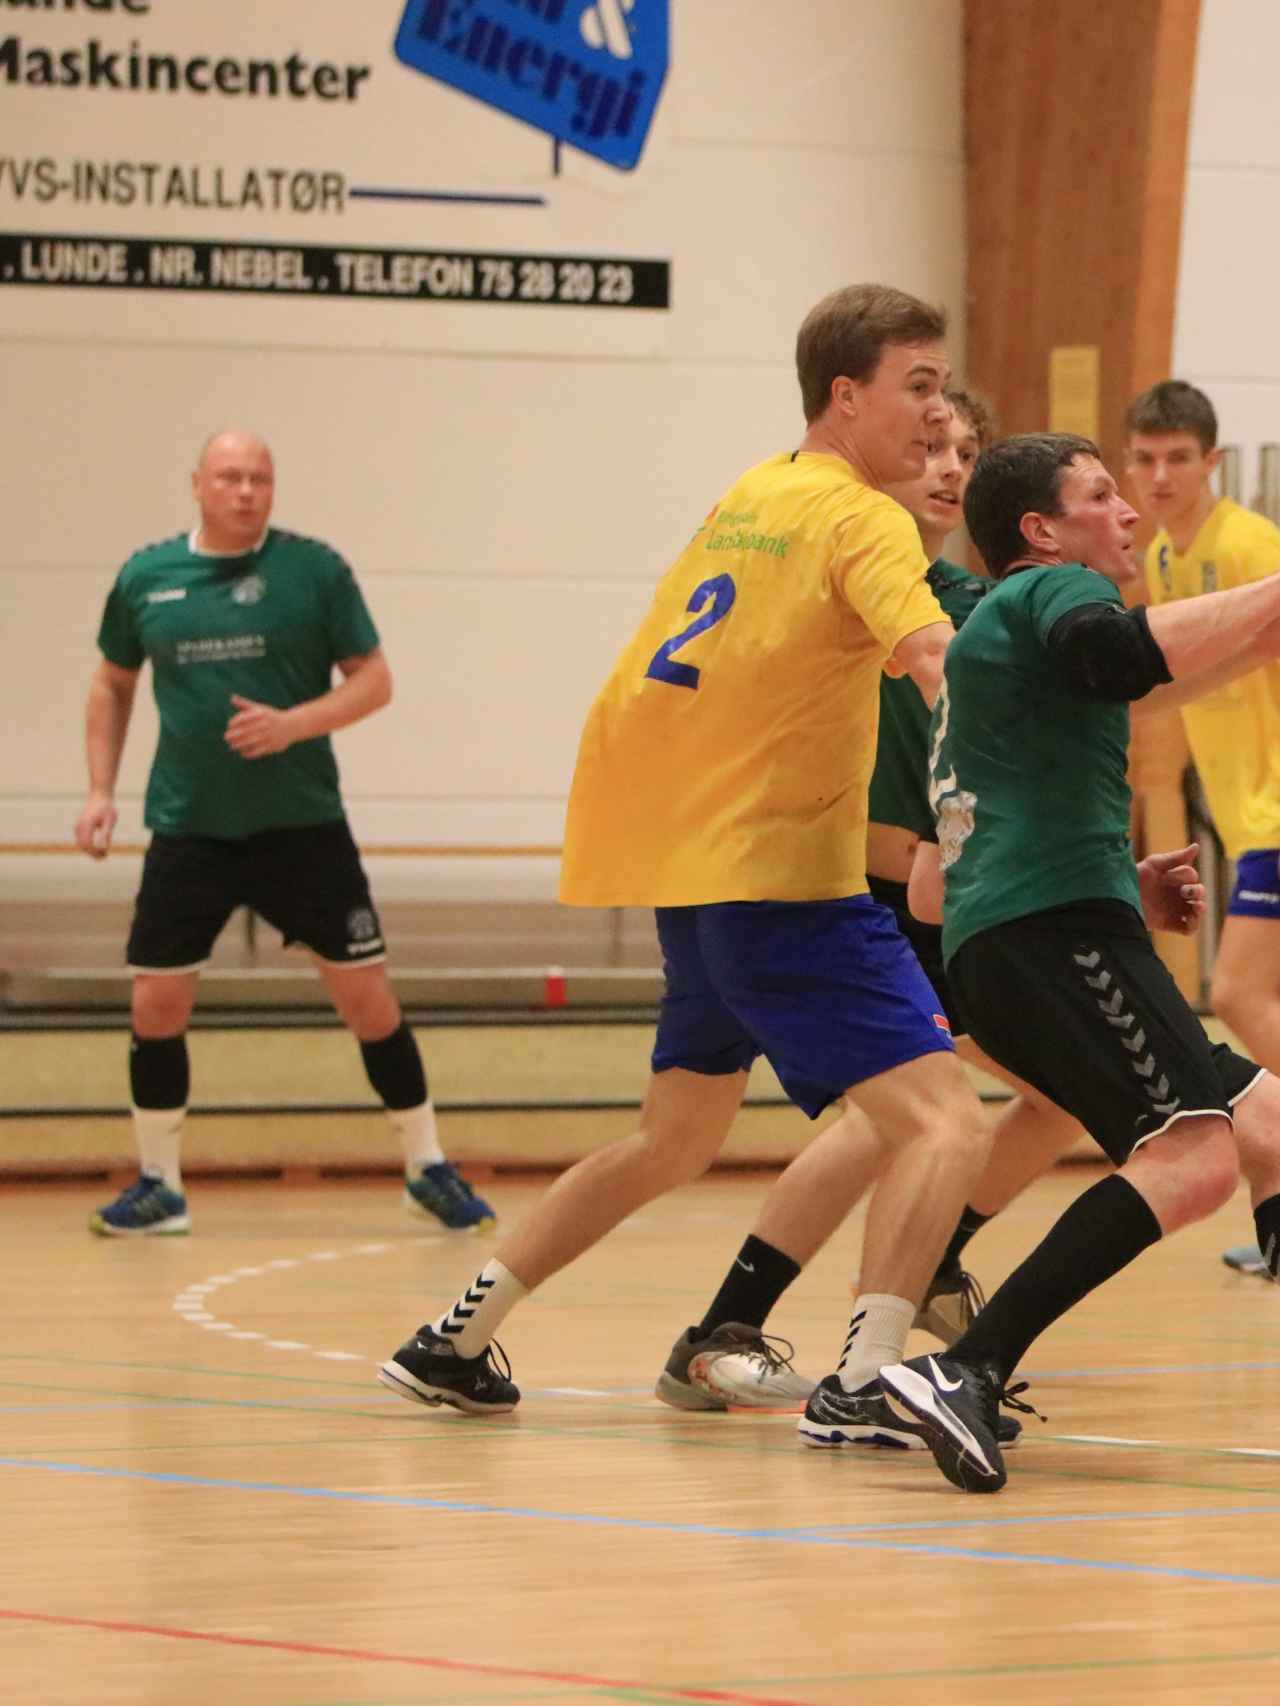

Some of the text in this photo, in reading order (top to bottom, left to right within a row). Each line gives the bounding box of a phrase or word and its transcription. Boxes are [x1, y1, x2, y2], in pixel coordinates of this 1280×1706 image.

[0, 156, 347, 213] VS-INSTALLATØR
[21, 242, 129, 283] LUNDE
[151, 246, 203, 284] NR.
[210, 248, 312, 290] NEBEL
[334, 252, 474, 296] TELEFON
[558, 262, 595, 301] 20
[598, 264, 634, 303] 23
[644, 572, 737, 691] 2
